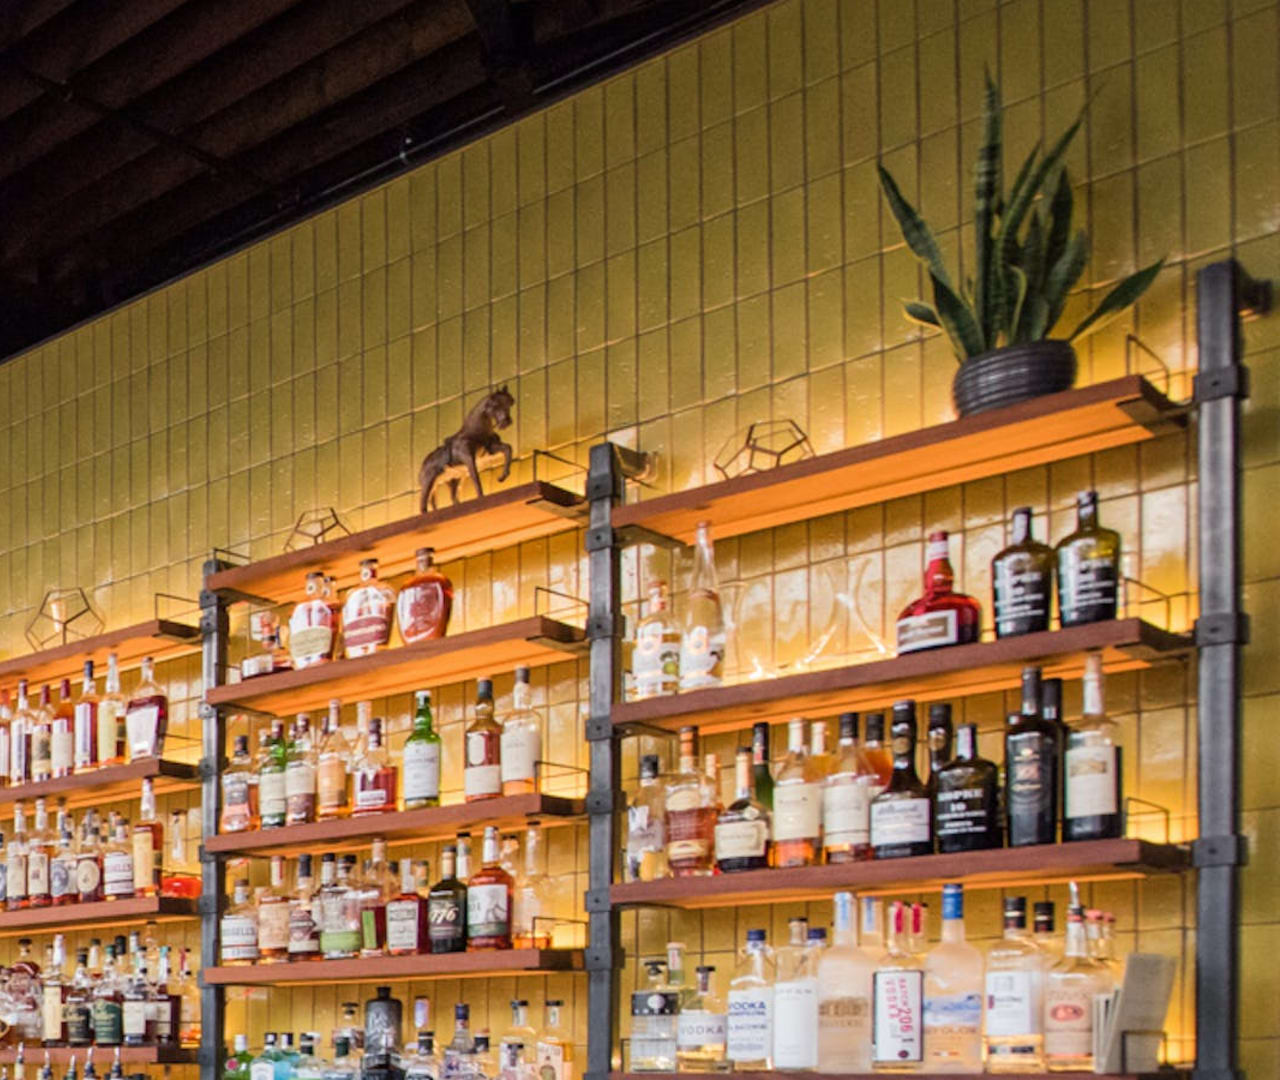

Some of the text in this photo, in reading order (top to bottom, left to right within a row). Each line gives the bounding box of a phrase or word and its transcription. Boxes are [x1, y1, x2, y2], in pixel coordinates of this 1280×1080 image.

[728, 1000, 767, 1010] VODKA
[897, 1008, 913, 1033] 206
[680, 1024, 724, 1035] VODKA
